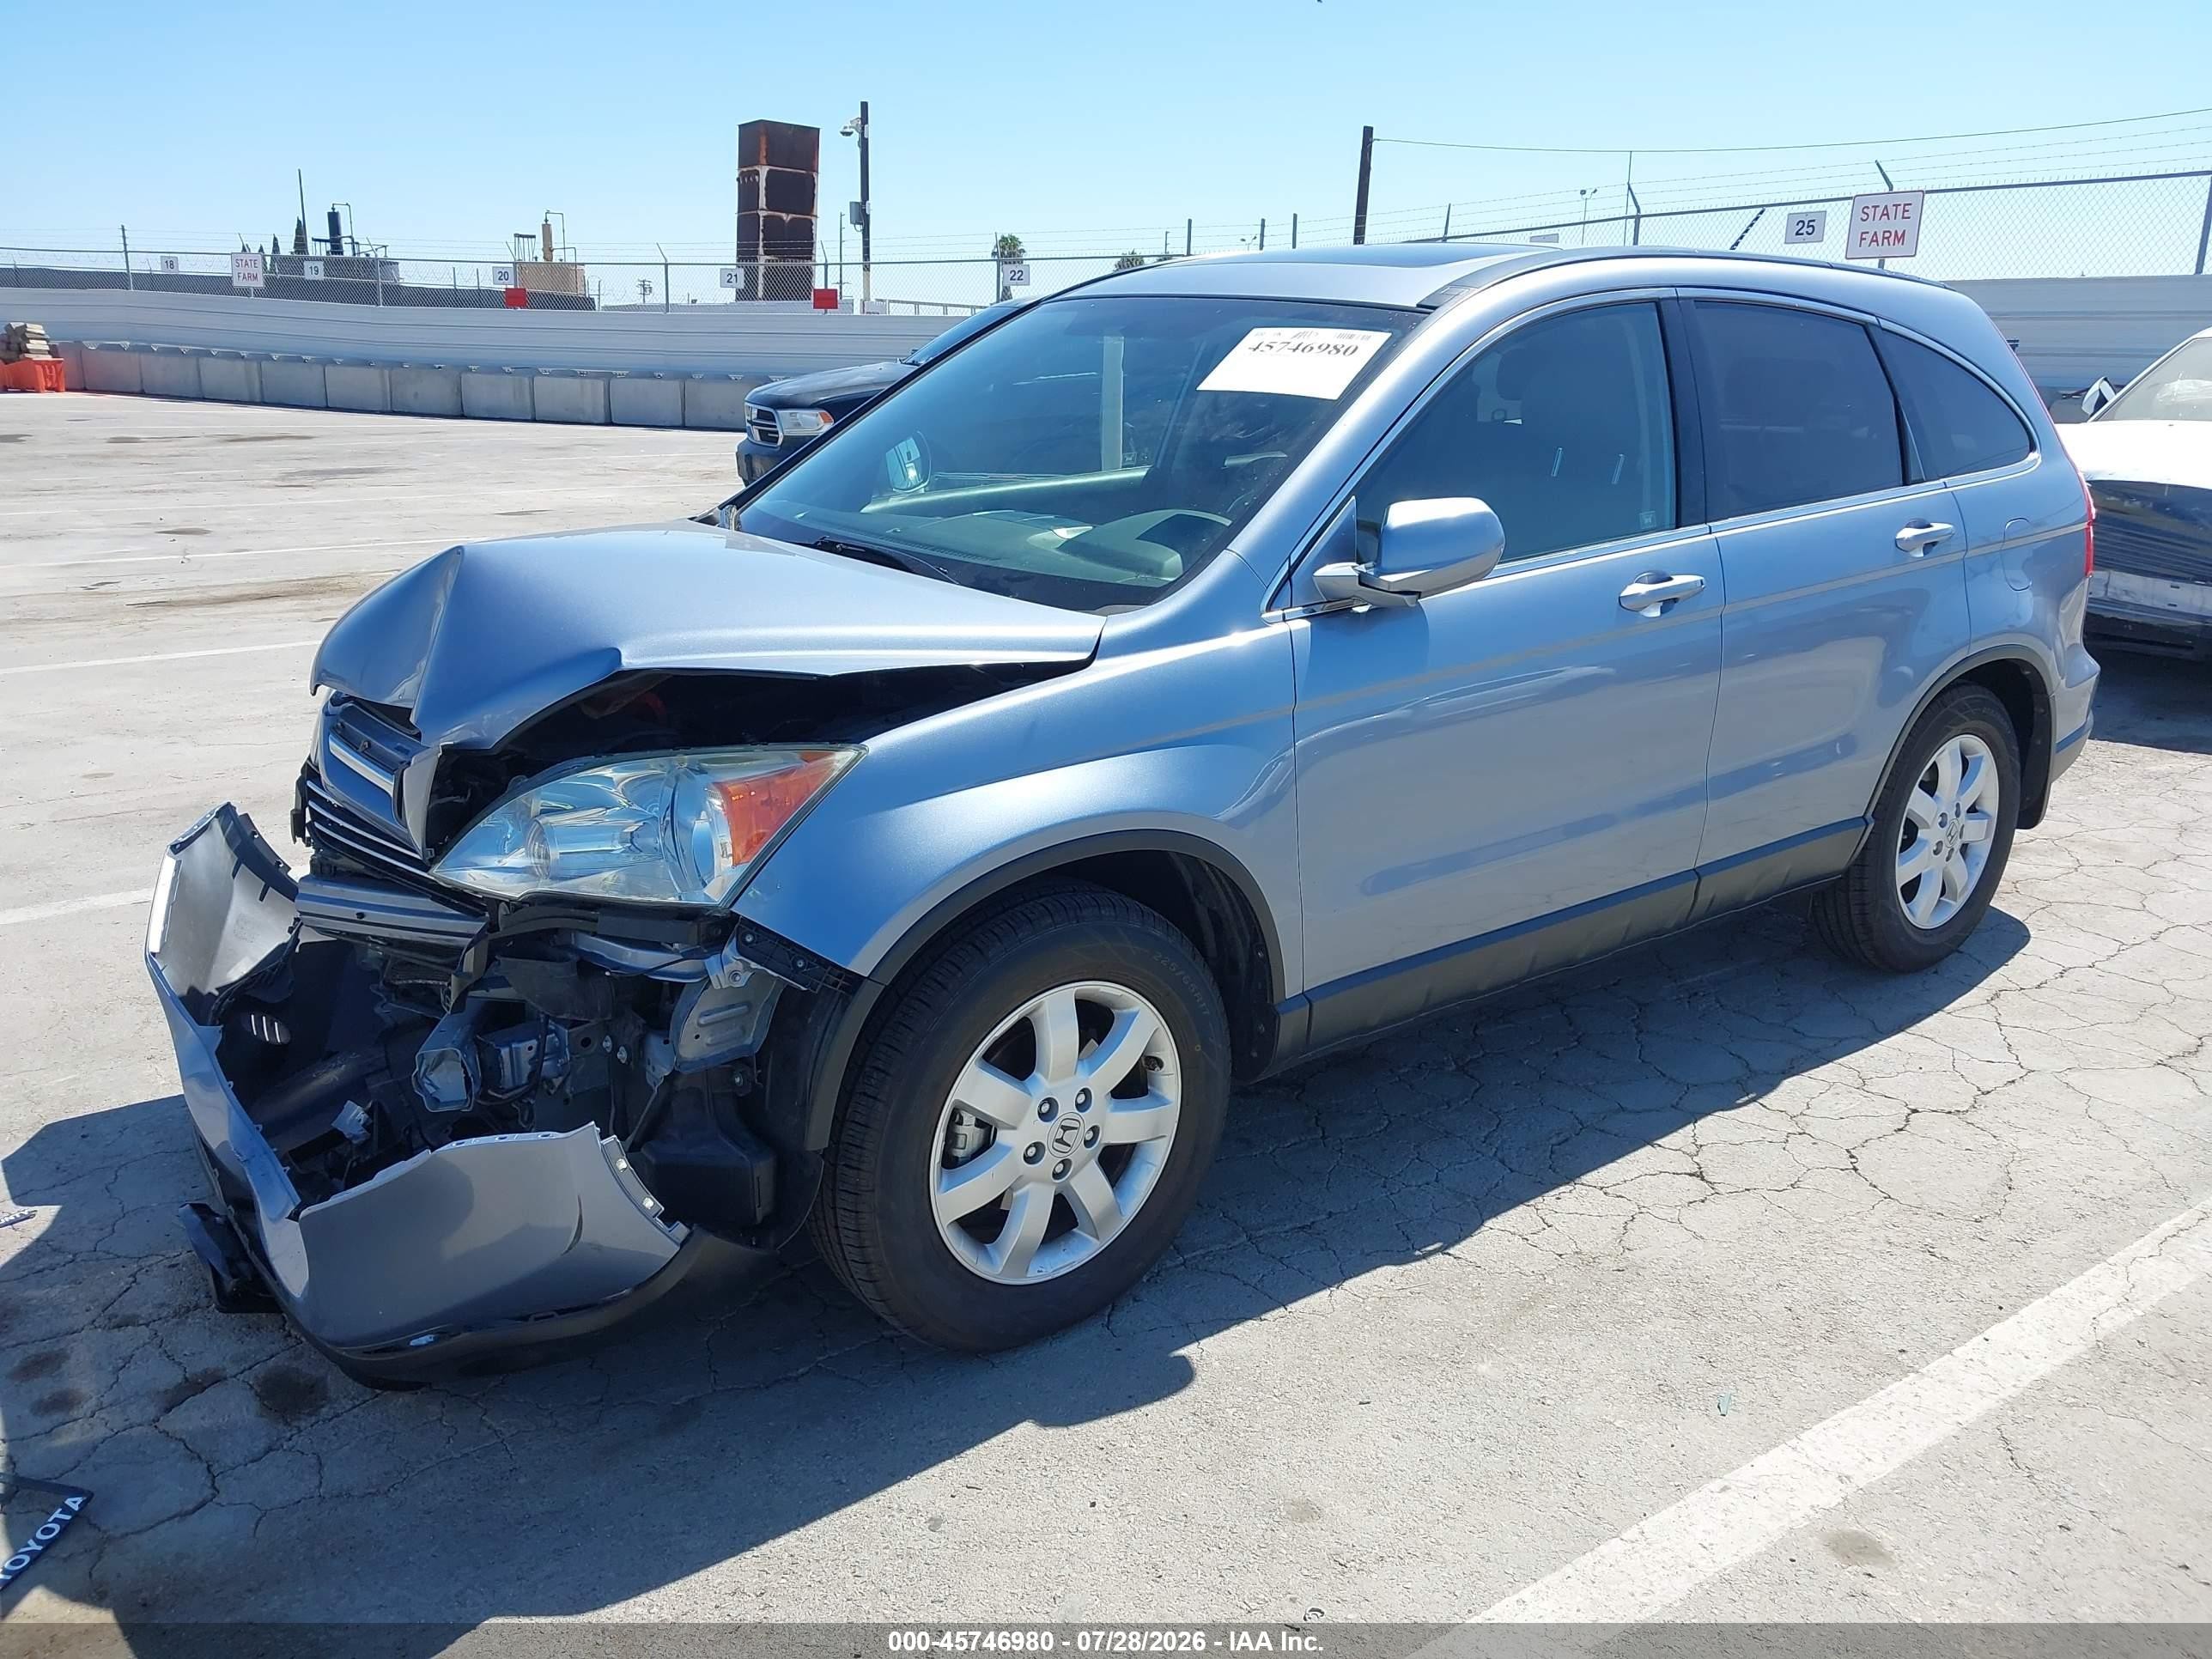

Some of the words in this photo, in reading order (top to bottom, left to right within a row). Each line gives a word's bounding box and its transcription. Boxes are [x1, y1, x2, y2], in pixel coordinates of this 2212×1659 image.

[1860, 203, 1912, 222] STATE
[1795, 219, 1816, 236] 25
[1858, 229, 1905, 248] FARM
[164, 260, 174, 270] 18
[235, 258, 258, 269] STATE
[309, 265, 319, 276] 19
[497, 270, 509, 281] 20
[1009, 270, 1024, 282] 22
[237, 272, 258, 282] FARM
[726, 272, 738, 283] 21
[1248, 341, 1359, 356] 45746980
